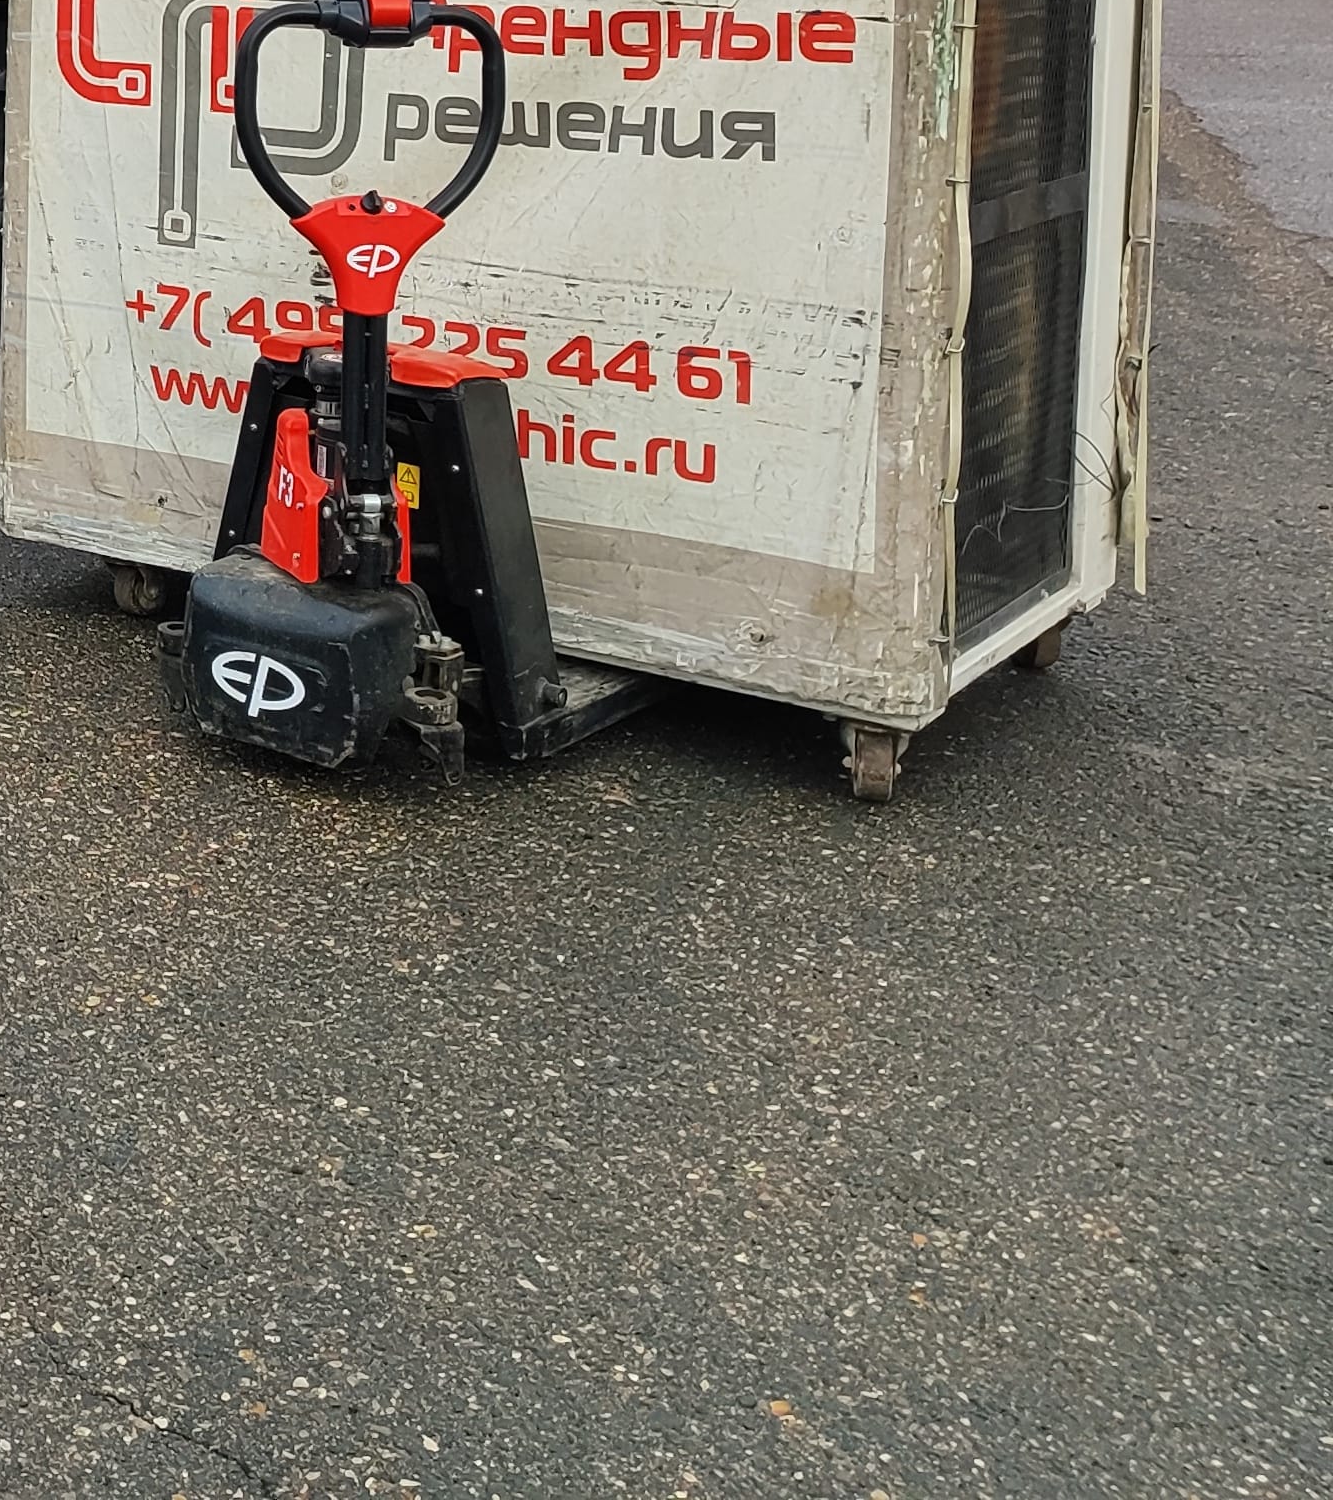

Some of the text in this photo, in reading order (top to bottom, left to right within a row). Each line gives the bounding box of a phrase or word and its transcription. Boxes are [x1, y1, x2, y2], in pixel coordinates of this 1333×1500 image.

[383, 93, 776, 161] решения
[346, 244, 401, 278] EP
[547, 335, 657, 392] 44
[677, 345, 751, 405] 61
[211, 650, 306, 718] EP
